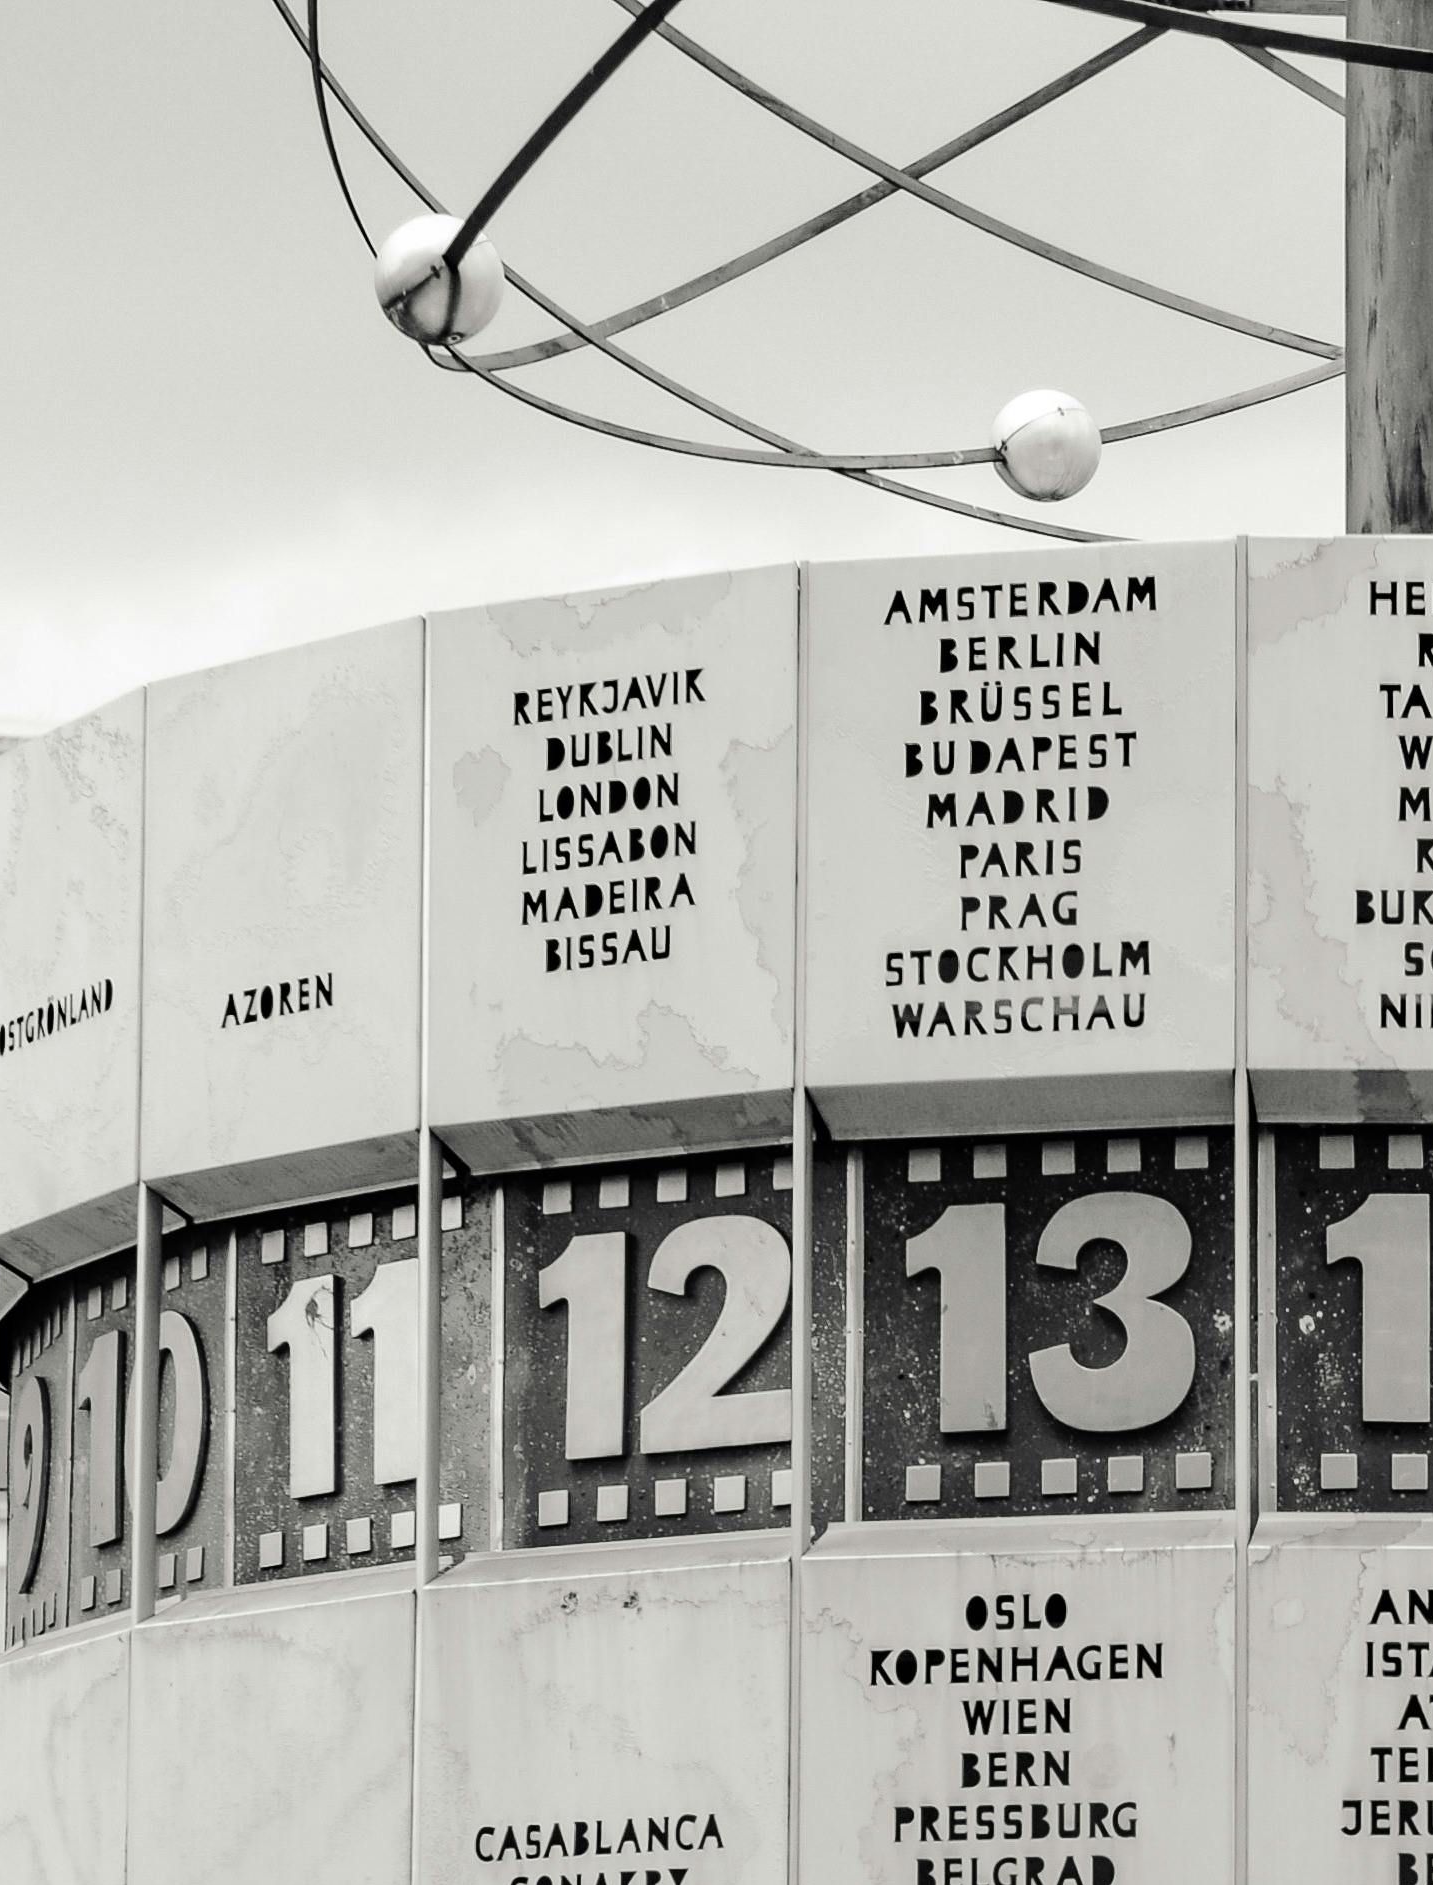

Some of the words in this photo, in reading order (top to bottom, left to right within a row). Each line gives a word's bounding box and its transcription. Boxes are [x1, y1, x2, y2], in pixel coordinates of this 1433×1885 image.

[883, 575, 1157, 626] AMSTERDAM
[939, 630, 1101, 674] BERLIN
[513, 668, 706, 726] REYKJAVIK
[919, 680, 1123, 726] BRÜSSEL
[546, 722, 673, 772] DUBLIN
[904, 730, 1137, 779] BUDAPEST
[538, 772, 679, 823] LONDON
[926, 785, 1110, 829] MADRID
[522, 820, 697, 875] LISSABON
[959, 839, 1082, 879] PARIS
[521, 872, 696, 926] MADEIRA
[960, 890, 1078, 932] PRAG
[545, 924, 671, 973] BISSAU
[885, 940, 1151, 987] STOCKHOLM
[0, 978, 113, 1056] OSTGRÖNLAND
[221, 972, 333, 1029] AZOREN
[891, 992, 1146, 1039] WARSCHAU
[906, 1192, 1195, 1433] 13
[539, 1214, 793, 1461] 12
[267, 1257, 420, 1499] 11
[78, 1310, 212, 1548] 10
[965, 1592, 1067, 1632] OSLO
[870, 1642, 1163, 1687] KOPENHAGEN
[961, 1697, 1071, 1736] WIEN
[960, 1750, 1071, 1789] BERN
[475, 1813, 724, 1863] CASABLANCA
[894, 1801, 1138, 1843] PRESSBURG
